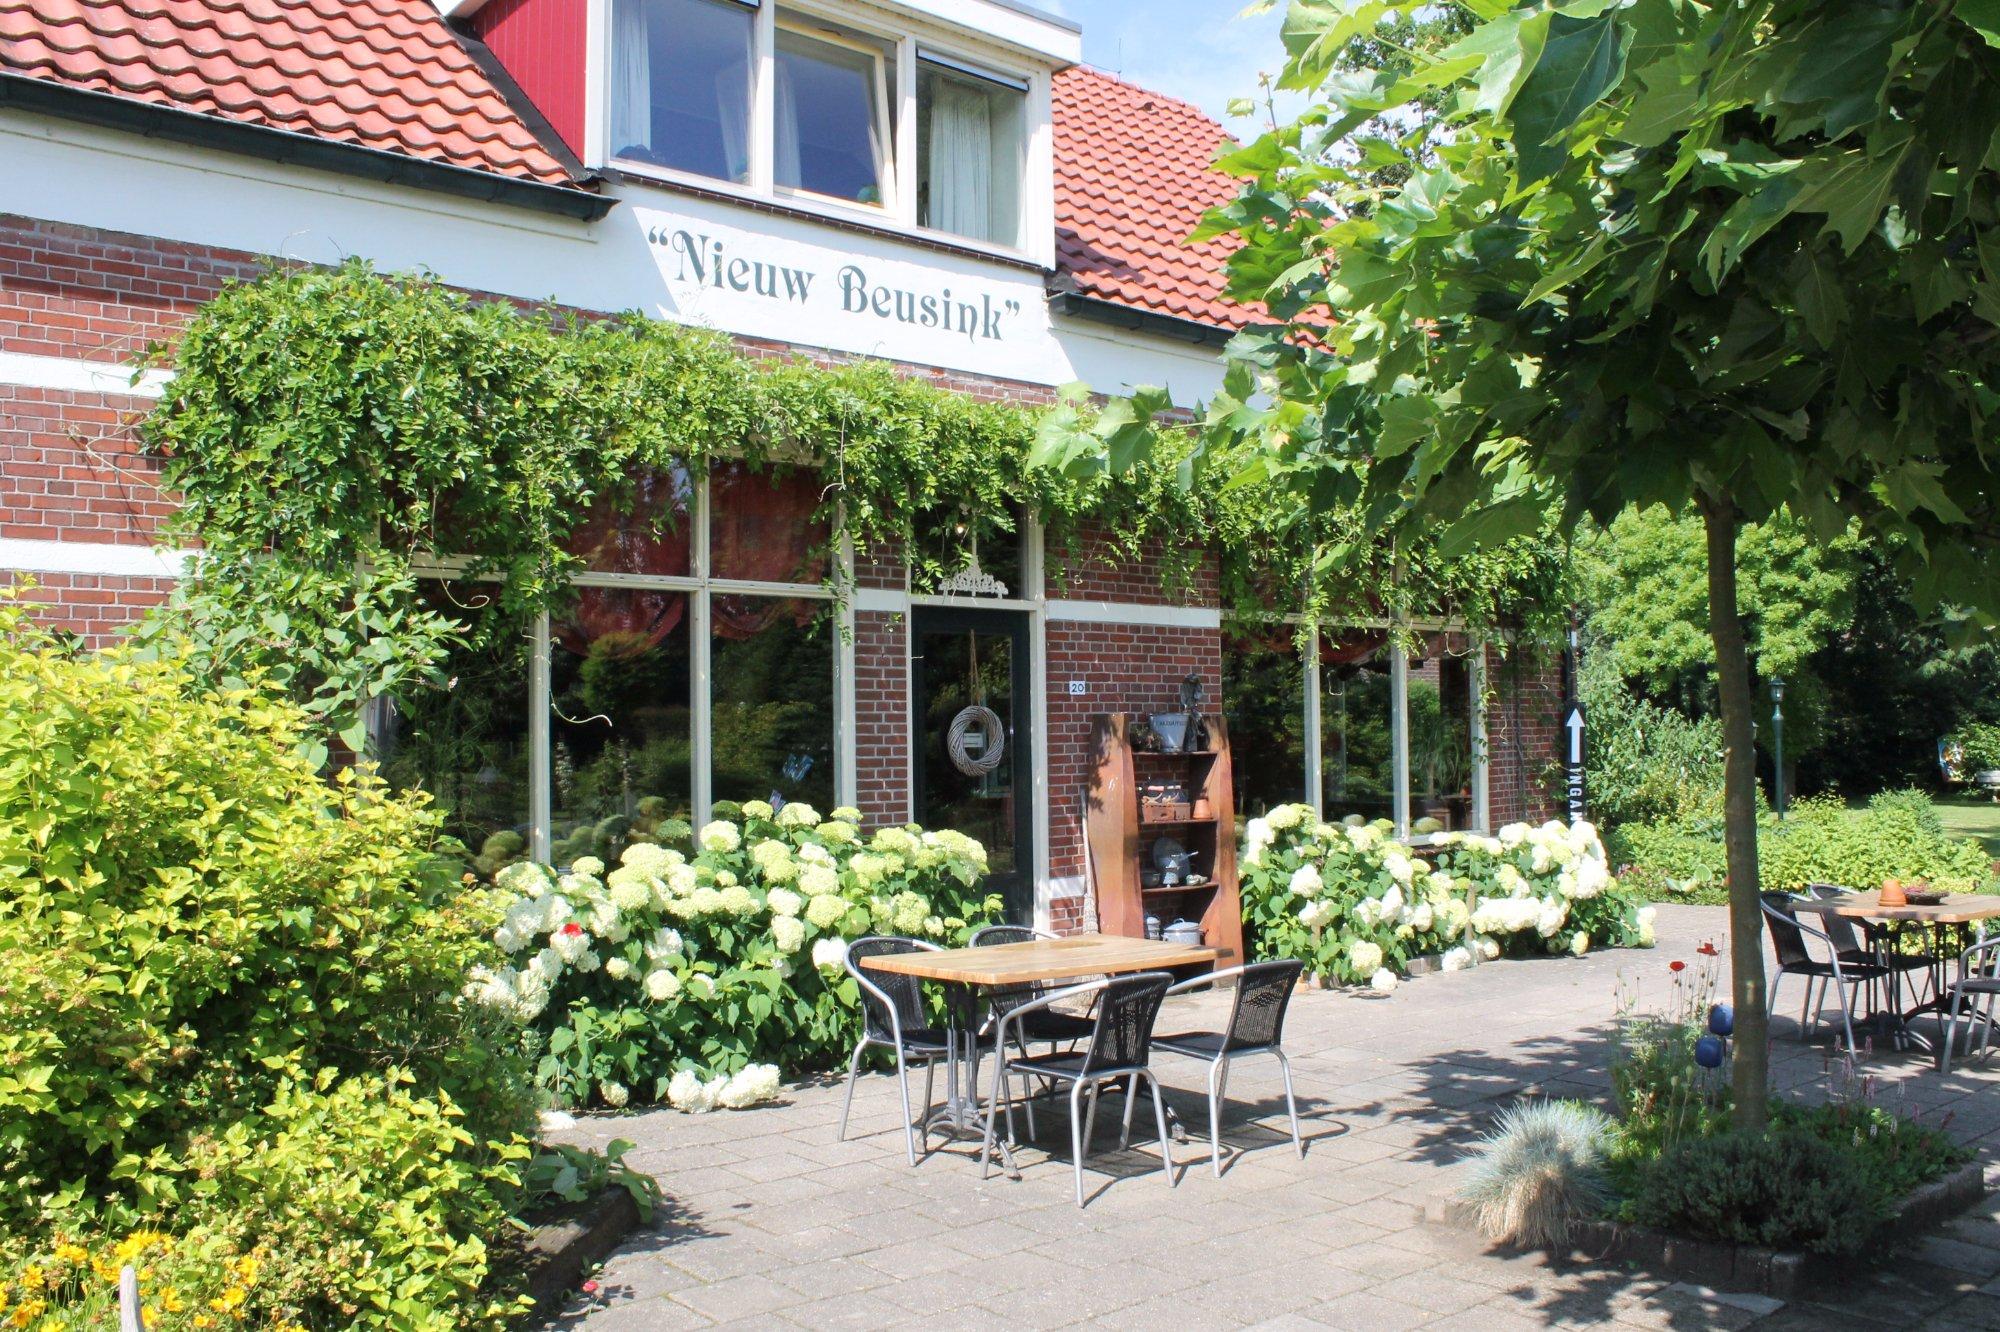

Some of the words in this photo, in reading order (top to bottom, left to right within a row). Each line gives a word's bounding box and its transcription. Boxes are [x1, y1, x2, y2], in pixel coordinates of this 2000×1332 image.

[648, 226, 815, 304] “Nieuw
[838, 265, 1020, 343] Beusink”
[1071, 683, 1085, 693] 20
